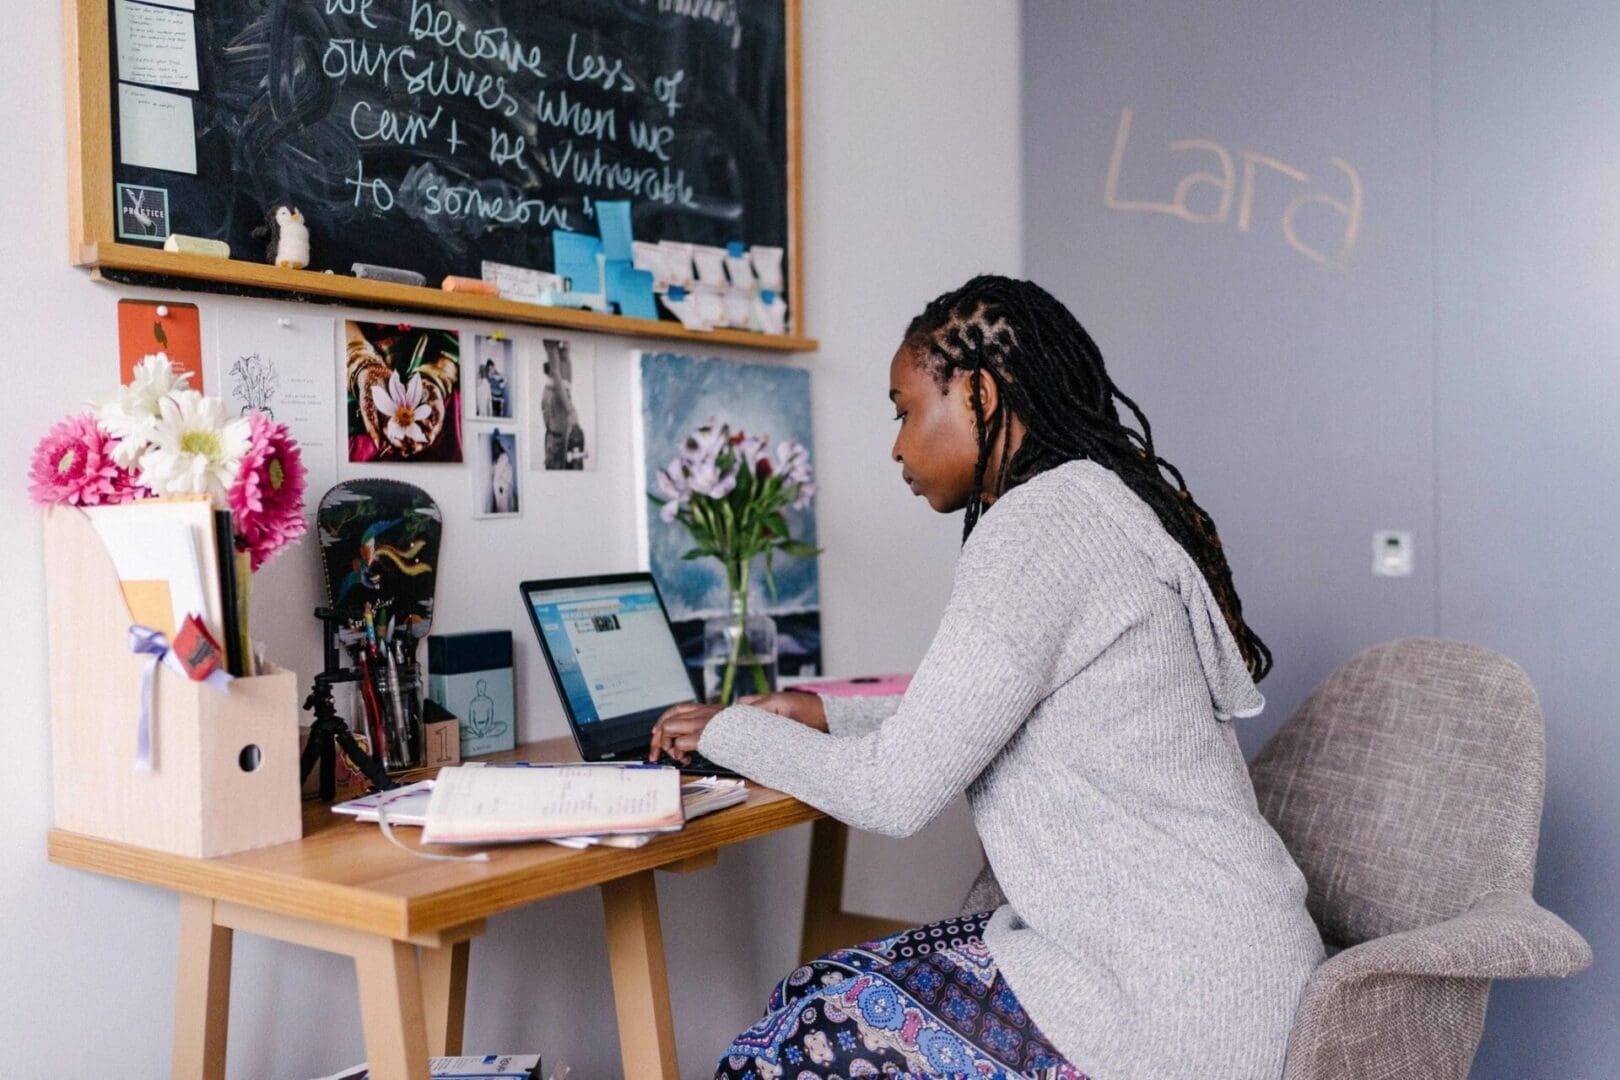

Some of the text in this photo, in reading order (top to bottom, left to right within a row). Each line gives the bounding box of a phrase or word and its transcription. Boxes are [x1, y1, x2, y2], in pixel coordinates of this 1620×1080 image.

[409, 0, 547, 78] become
[566, 32, 635, 92] less
[654, 69, 684, 118] of
[490, 127, 529, 170] be
[537, 90, 616, 141] when
[629, 121, 675, 161] we
[123, 206, 164, 219] PRCTICE
[345, 160, 394, 212] to
[1104, 106, 1363, 267] Lara
